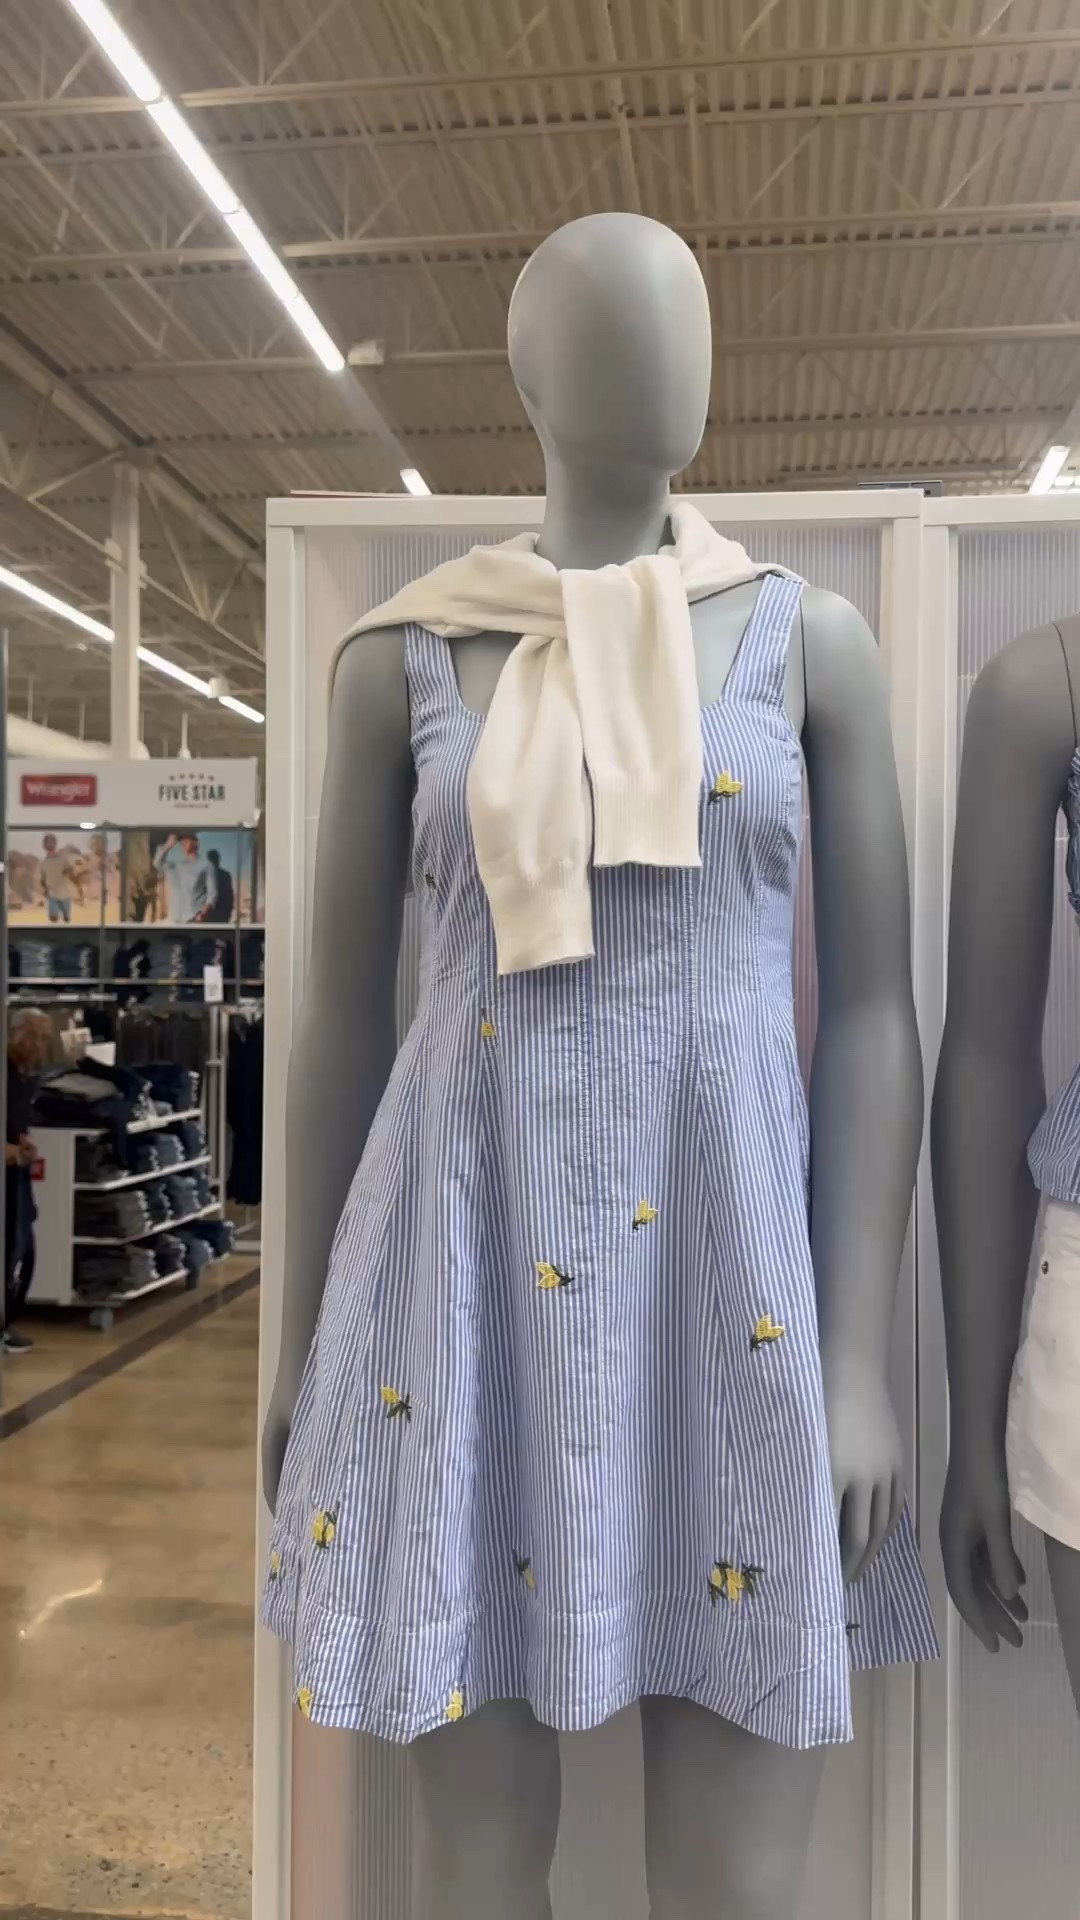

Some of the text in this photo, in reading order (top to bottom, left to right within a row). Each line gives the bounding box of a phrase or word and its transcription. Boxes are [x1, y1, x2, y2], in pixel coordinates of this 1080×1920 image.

[26, 781, 90, 803] Wrangler
[159, 784, 225, 801] FIVE STAR
